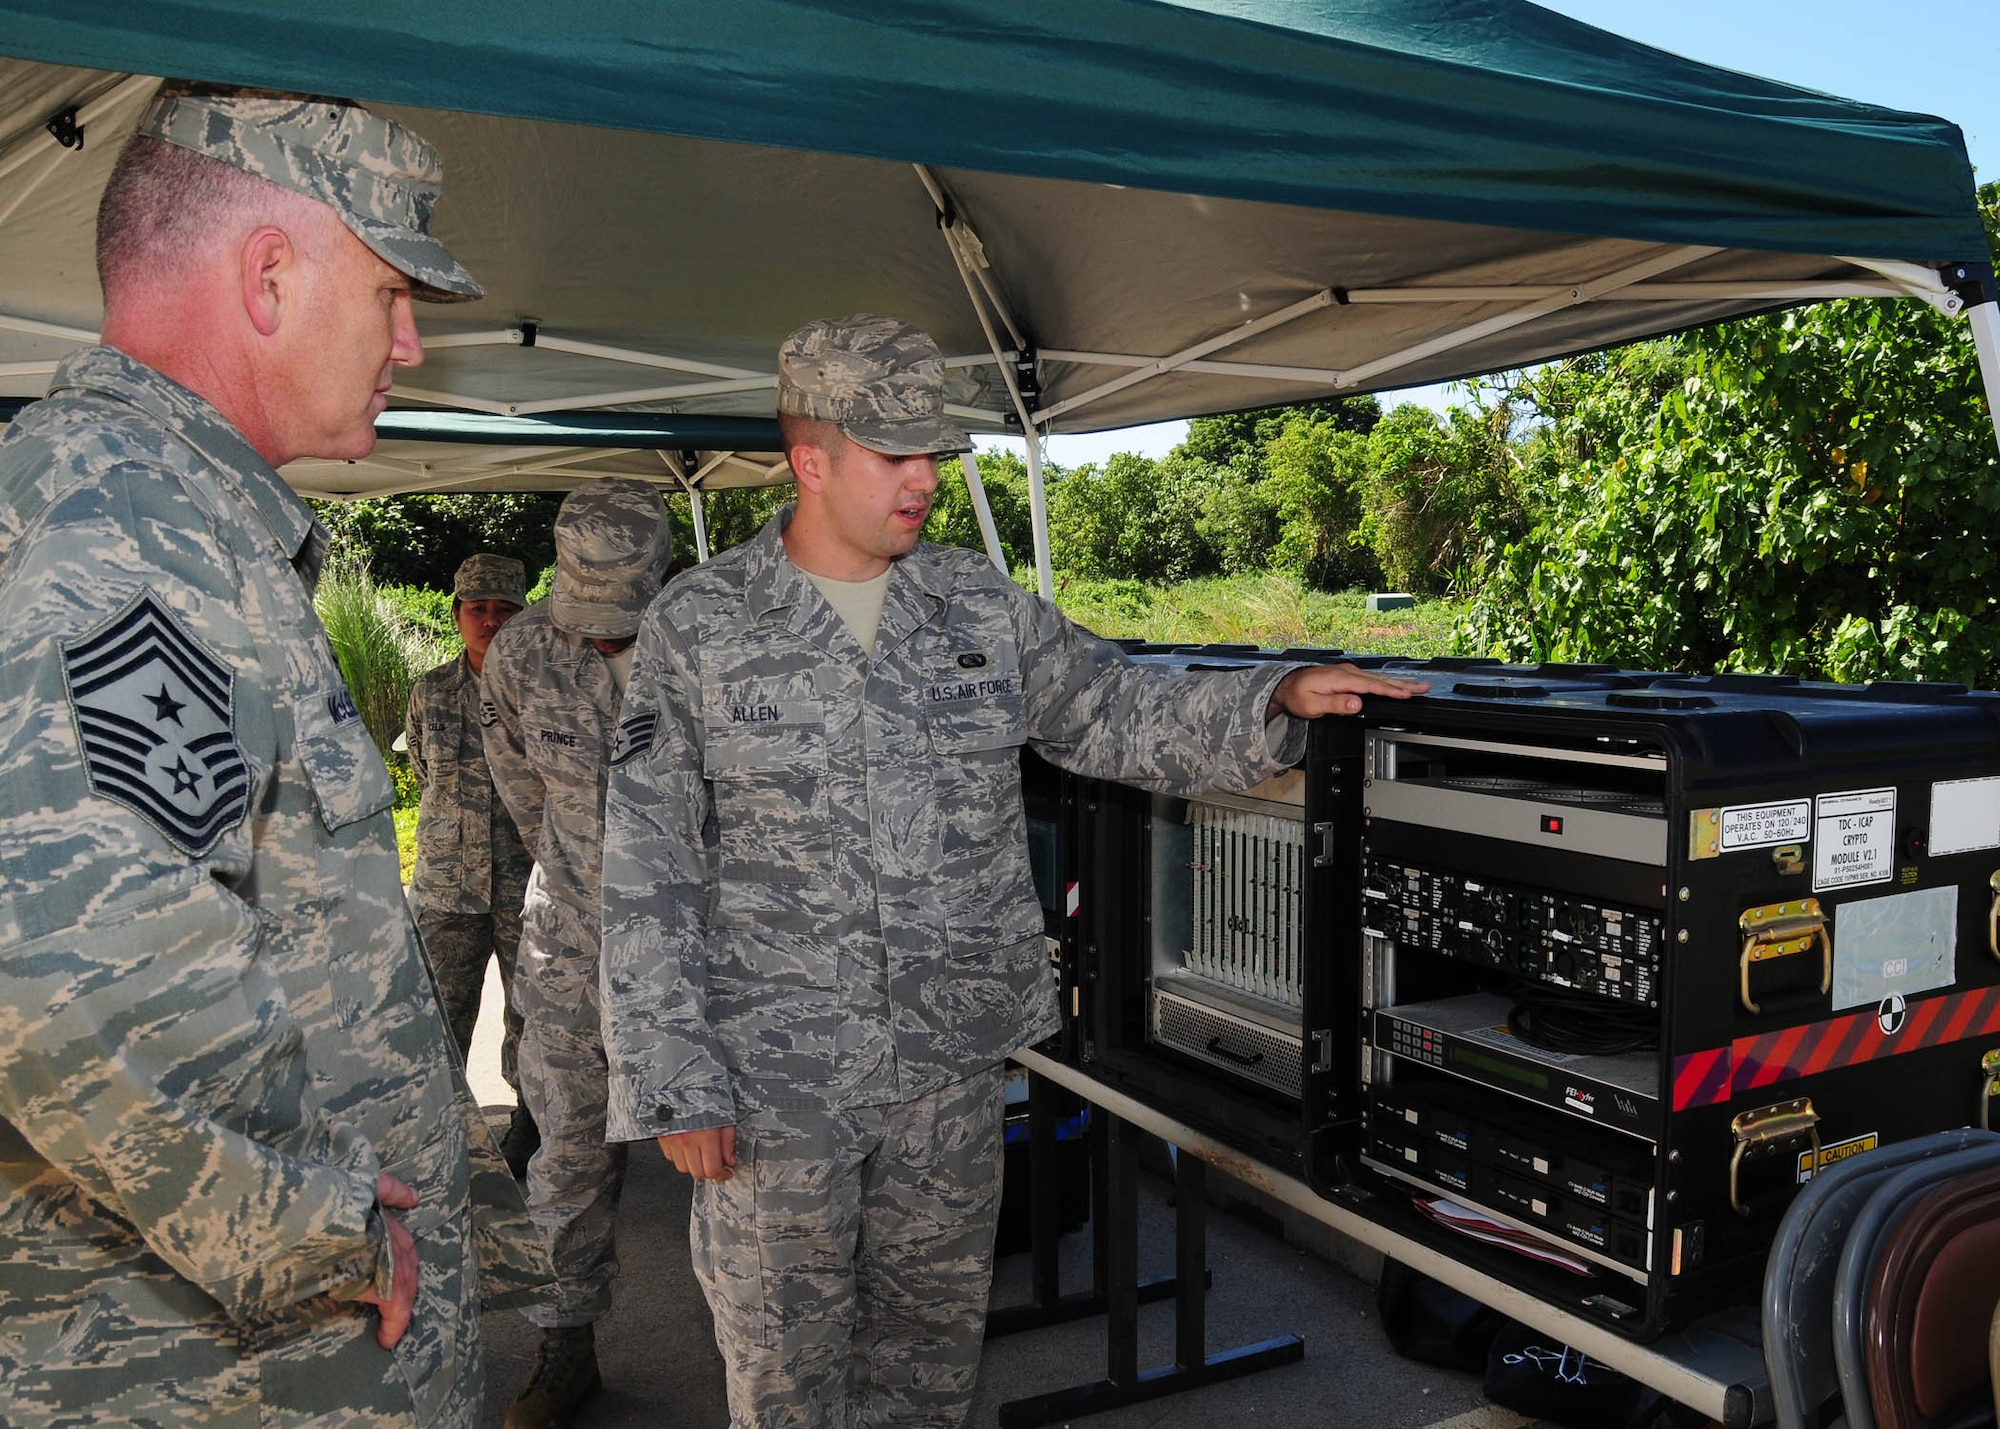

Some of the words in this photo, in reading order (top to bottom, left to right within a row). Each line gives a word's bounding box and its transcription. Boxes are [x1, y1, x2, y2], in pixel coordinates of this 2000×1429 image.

[931, 687, 956, 702] U.S.
[957, 684, 978, 700] AIR
[979, 679, 1012, 696] FORCE
[732, 705, 778, 724] ALLEN
[540, 729, 576, 748] PRINCE
[1736, 812, 1752, 822] THIS
[1756, 808, 1796, 820] EQUIPMENT
[1724, 821, 1762, 834] OPERATES
[1764, 820, 1775, 829] ON
[1839, 818, 1852, 830] TDC
[1858, 816, 1874, 828] ICAP
[1764, 828, 1794, 839] 50-60Hz
[1842, 832, 1868, 846] CRYPTO
[1830, 851, 1860, 866] MODULE
[1863, 848, 1877, 861] V2.1
[1817, 876, 1830, 886] CAGE
[1831, 875, 1844, 884] CODE
[1825, 1142, 1865, 1161] CAUTION
